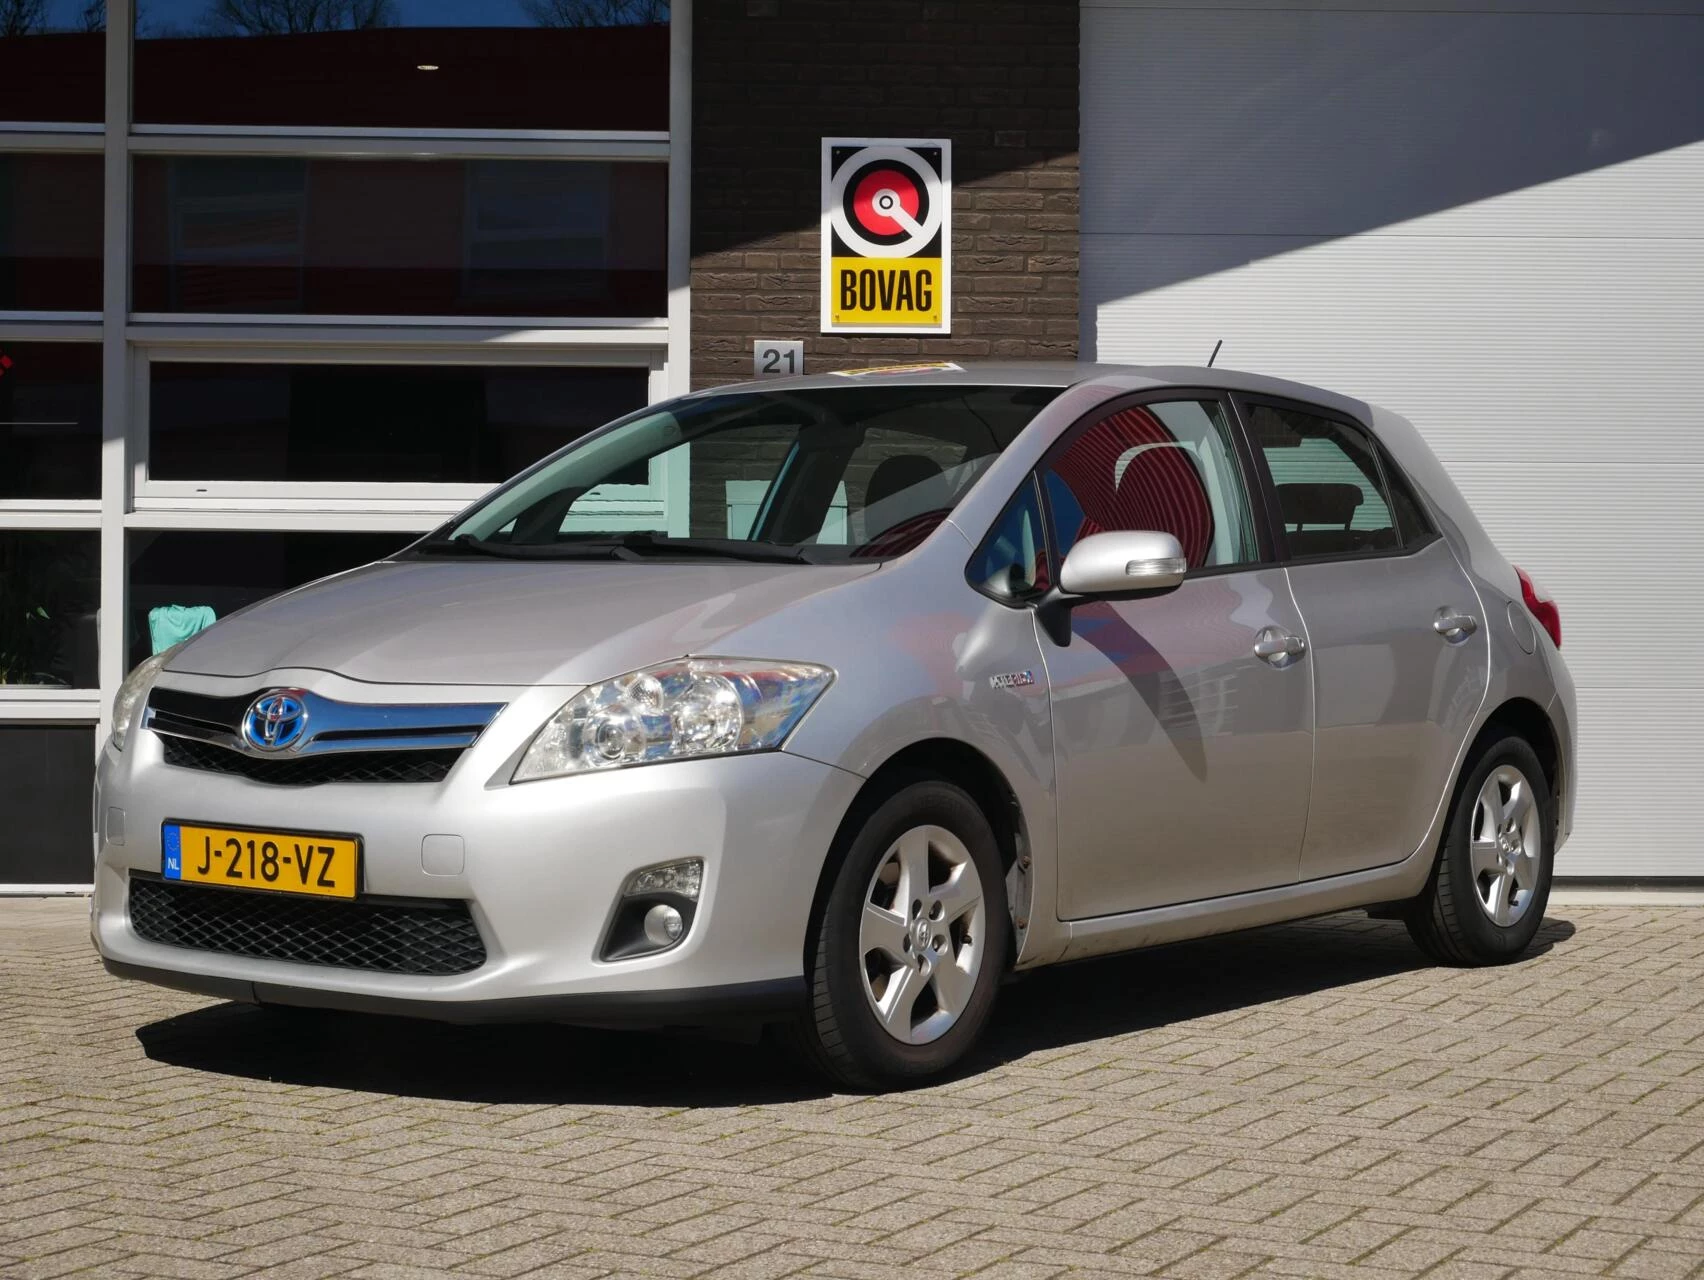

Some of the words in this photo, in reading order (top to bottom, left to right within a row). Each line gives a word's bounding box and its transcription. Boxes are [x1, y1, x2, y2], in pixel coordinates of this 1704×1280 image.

[840, 269, 932, 311] BOVAG
[762, 349, 795, 374] 21
[167, 857, 180, 871] NL
[197, 836, 335, 888] J-218-VZ
